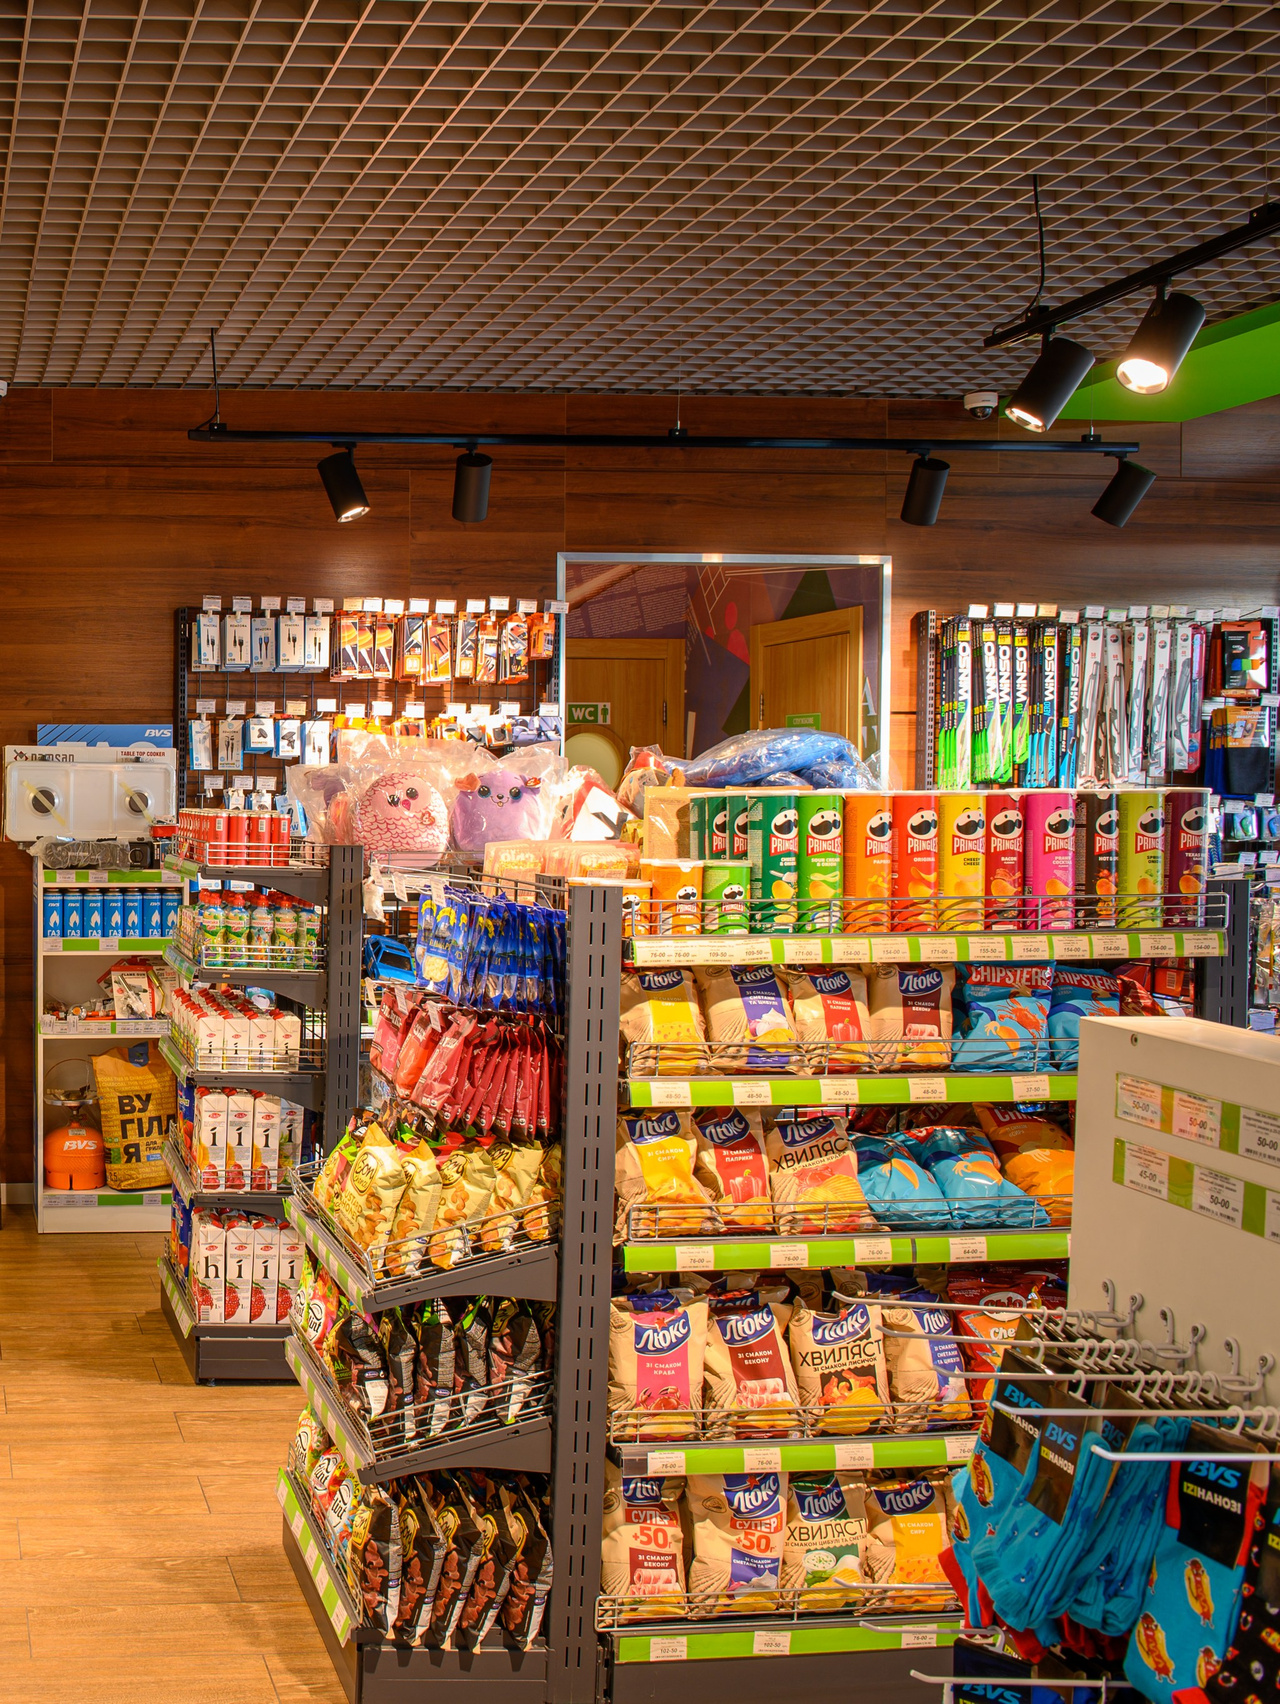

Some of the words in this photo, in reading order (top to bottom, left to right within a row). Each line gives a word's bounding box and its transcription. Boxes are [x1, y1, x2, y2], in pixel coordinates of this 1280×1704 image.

[571, 707, 595, 721] WC
[144, 729, 172, 738] BVS
[120, 750, 136, 758] TABLE
[136, 750, 146, 758] TOP
[147, 750, 166, 758] COOKER
[807, 836, 842, 853] PRINGLES
[47, 929, 61, 938] ГАЗ
[67, 929, 80, 938] ГАЗ
[87, 929, 101, 938] ГАЗ
[108, 929, 121, 938] ГАЗ
[125, 929, 139, 938] ГАЗ
[816, 973, 849, 991] Люкс
[901, 971, 942, 991] Люкс
[117, 1093, 152, 1115] ВУ
[1132, 1100, 1150, 1113] 50-00
[631, 1114, 679, 1139] Люкс
[705, 1116, 746, 1143] Люкс
[1189, 1117, 1208, 1130] 50-00
[63, 1140, 98, 1151] BVS
[1257, 1136, 1279, 1151] 50-00
[122, 1143, 141, 1164] Я
[655, 1147, 684, 1156] СМАКОМ
[730, 1148, 755, 1156] СМАКОМ
[725, 1155, 753, 1163] ПАПРИКИ
[1139, 1170, 1157, 1183] 45-00
[1210, 1195, 1230, 1210] 50-00
[724, 1309, 772, 1340] Люкс
[813, 1307, 867, 1341] Люкс
[635, 1320, 690, 1350] Люкс
[989, 1326, 1016, 1341] Che
[745, 1349, 773, 1358] СМАКОМ
[654, 1361, 682, 1369] СМАКОМ
[744, 1357, 770, 1366] БЕКОНУ
[820, 1362, 847, 1372] СМАКОМ
[847, 1357, 878, 1367] ЛИСИЧОК
[653, 1368, 675, 1376] КРАБА
[1044, 1421, 1078, 1451] BVS
[1102, 1419, 1126, 1448] BVS
[1188, 1460, 1243, 1488] BVS
[731, 1476, 779, 1514] Люкс
[881, 1482, 934, 1513] Люкс
[803, 1486, 843, 1519] Люкс
[631, 1508, 669, 1524] СУПЕР
[734, 1518, 777, 1532] СУПЕР
[791, 1539, 816, 1547] СМАКОМ
[817, 1537, 840, 1545] ЦИБУЛІ
[659, 1647, 678, 1655] 102-50
